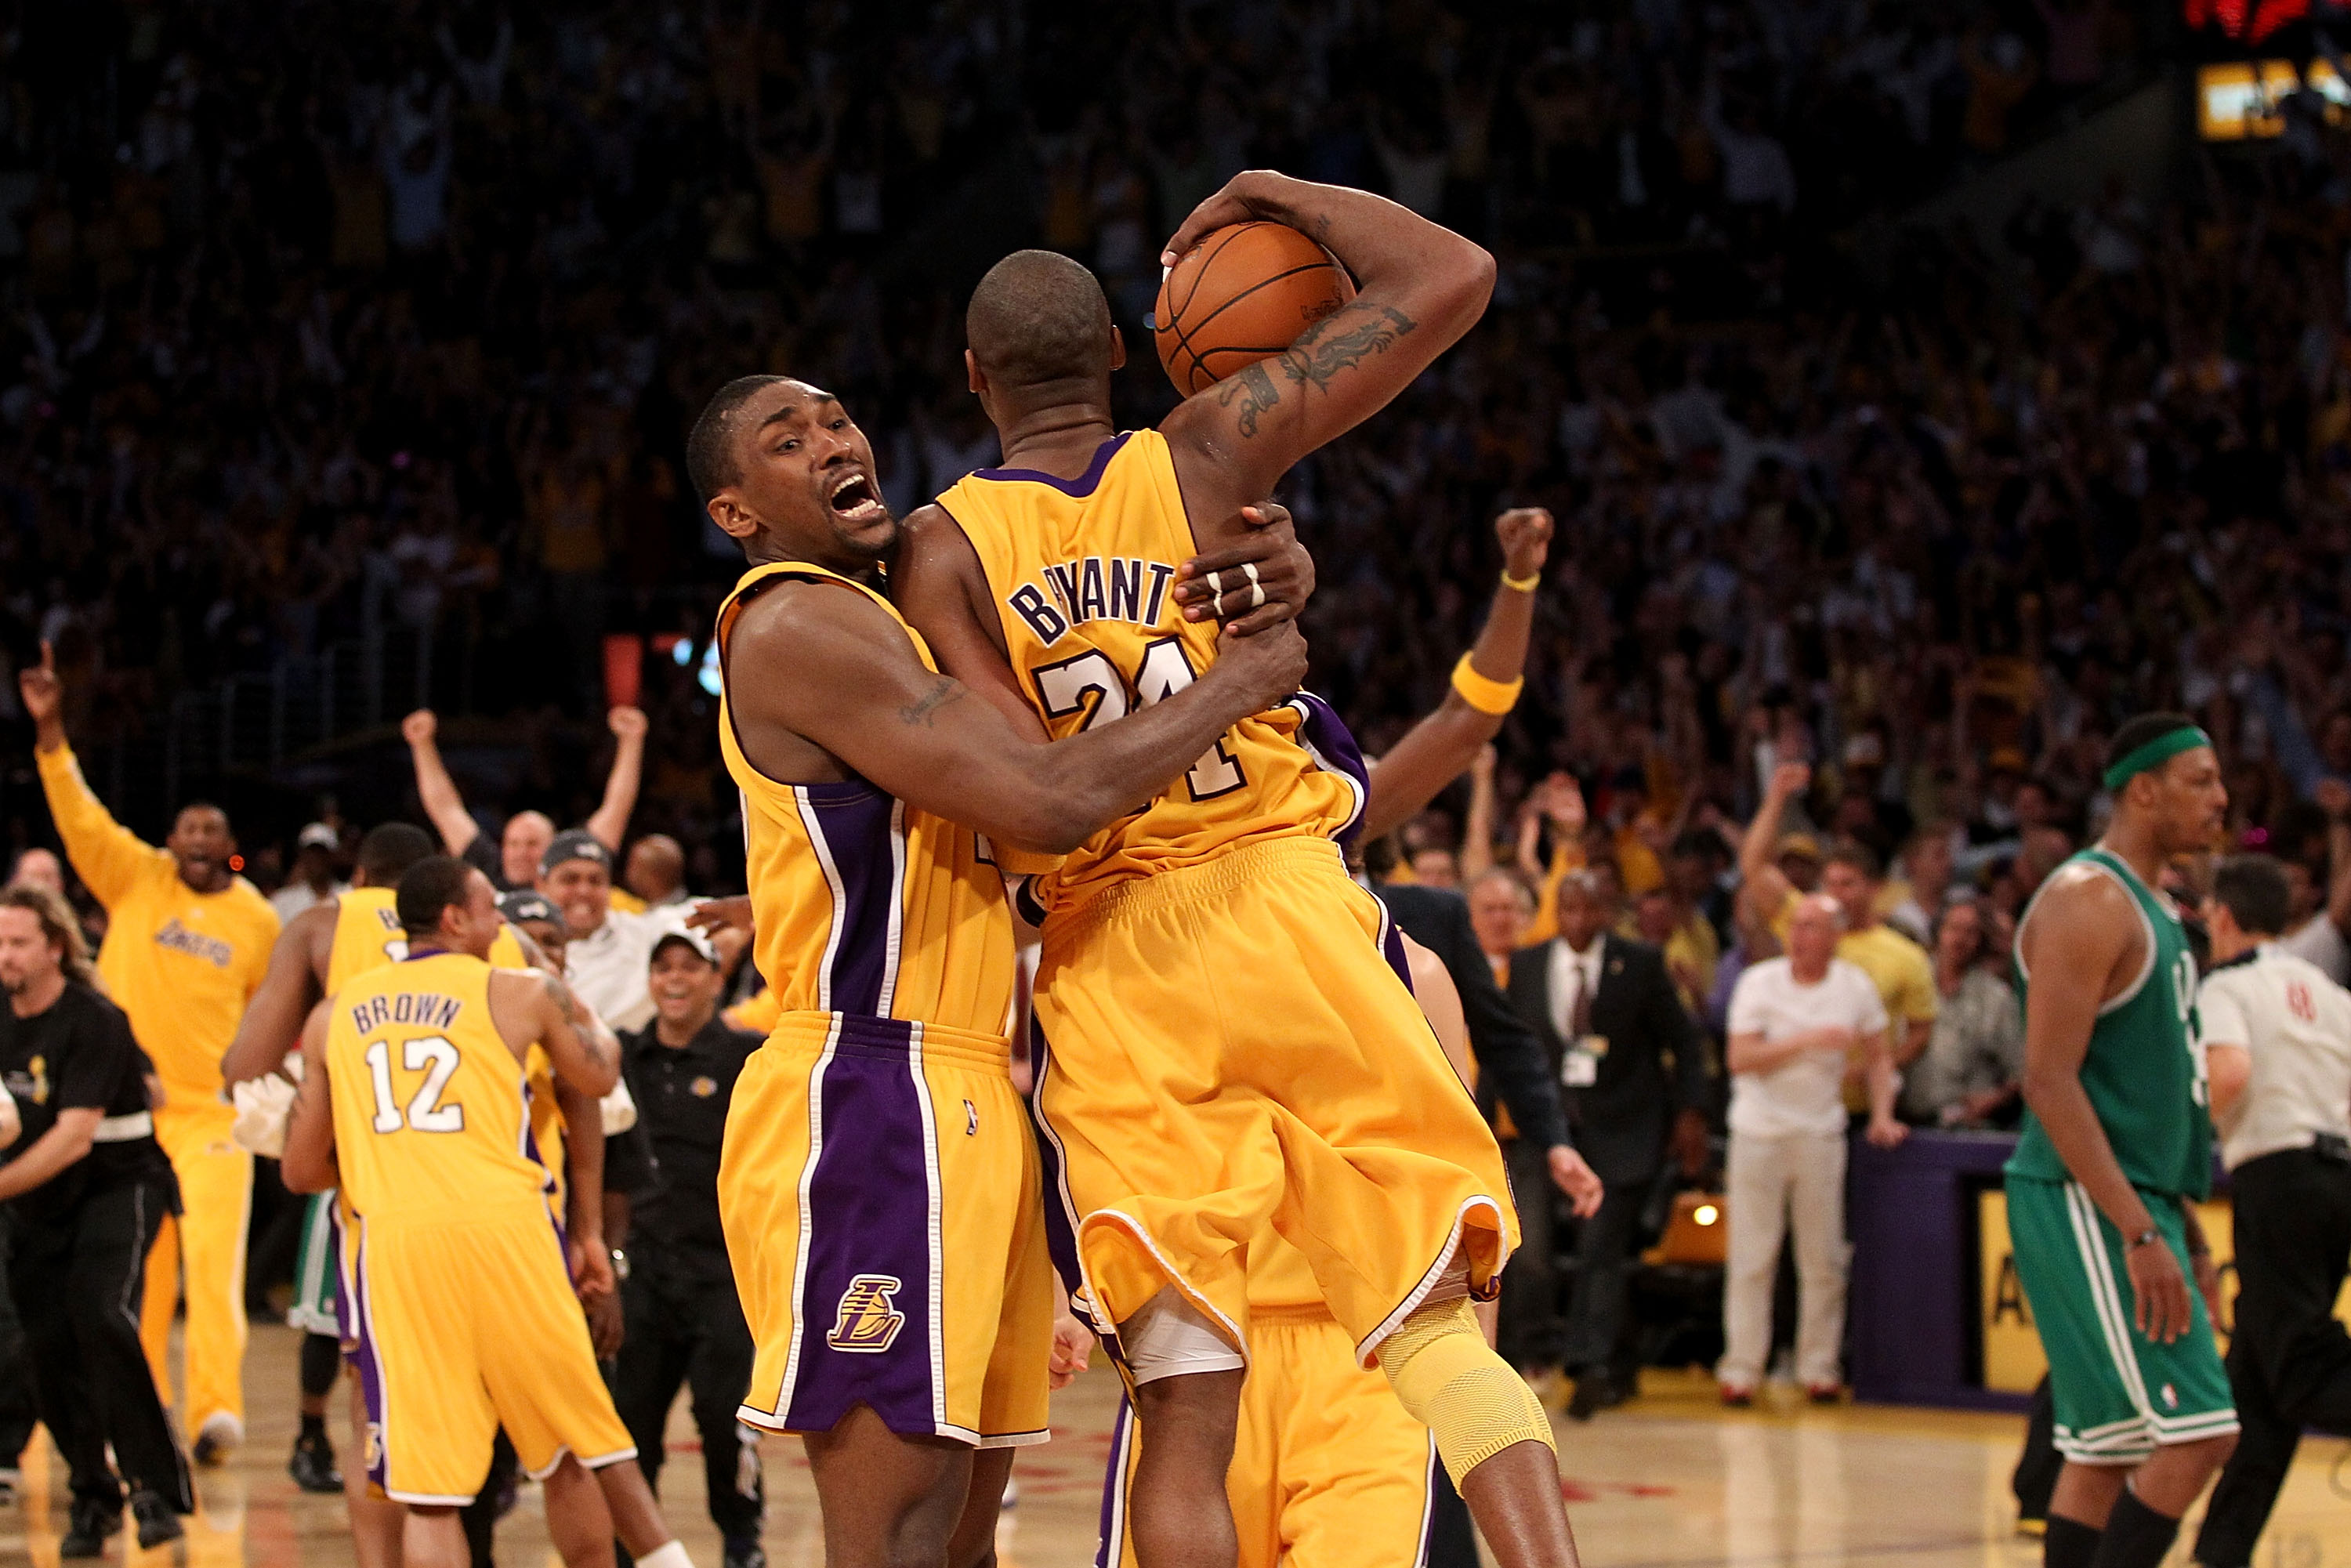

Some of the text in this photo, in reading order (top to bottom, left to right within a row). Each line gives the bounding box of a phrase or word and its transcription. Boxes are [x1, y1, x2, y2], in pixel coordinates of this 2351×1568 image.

[1031, 635, 1248, 817] 24
[352, 993, 462, 1035] BROWN
[365, 1034, 465, 1135] 12
